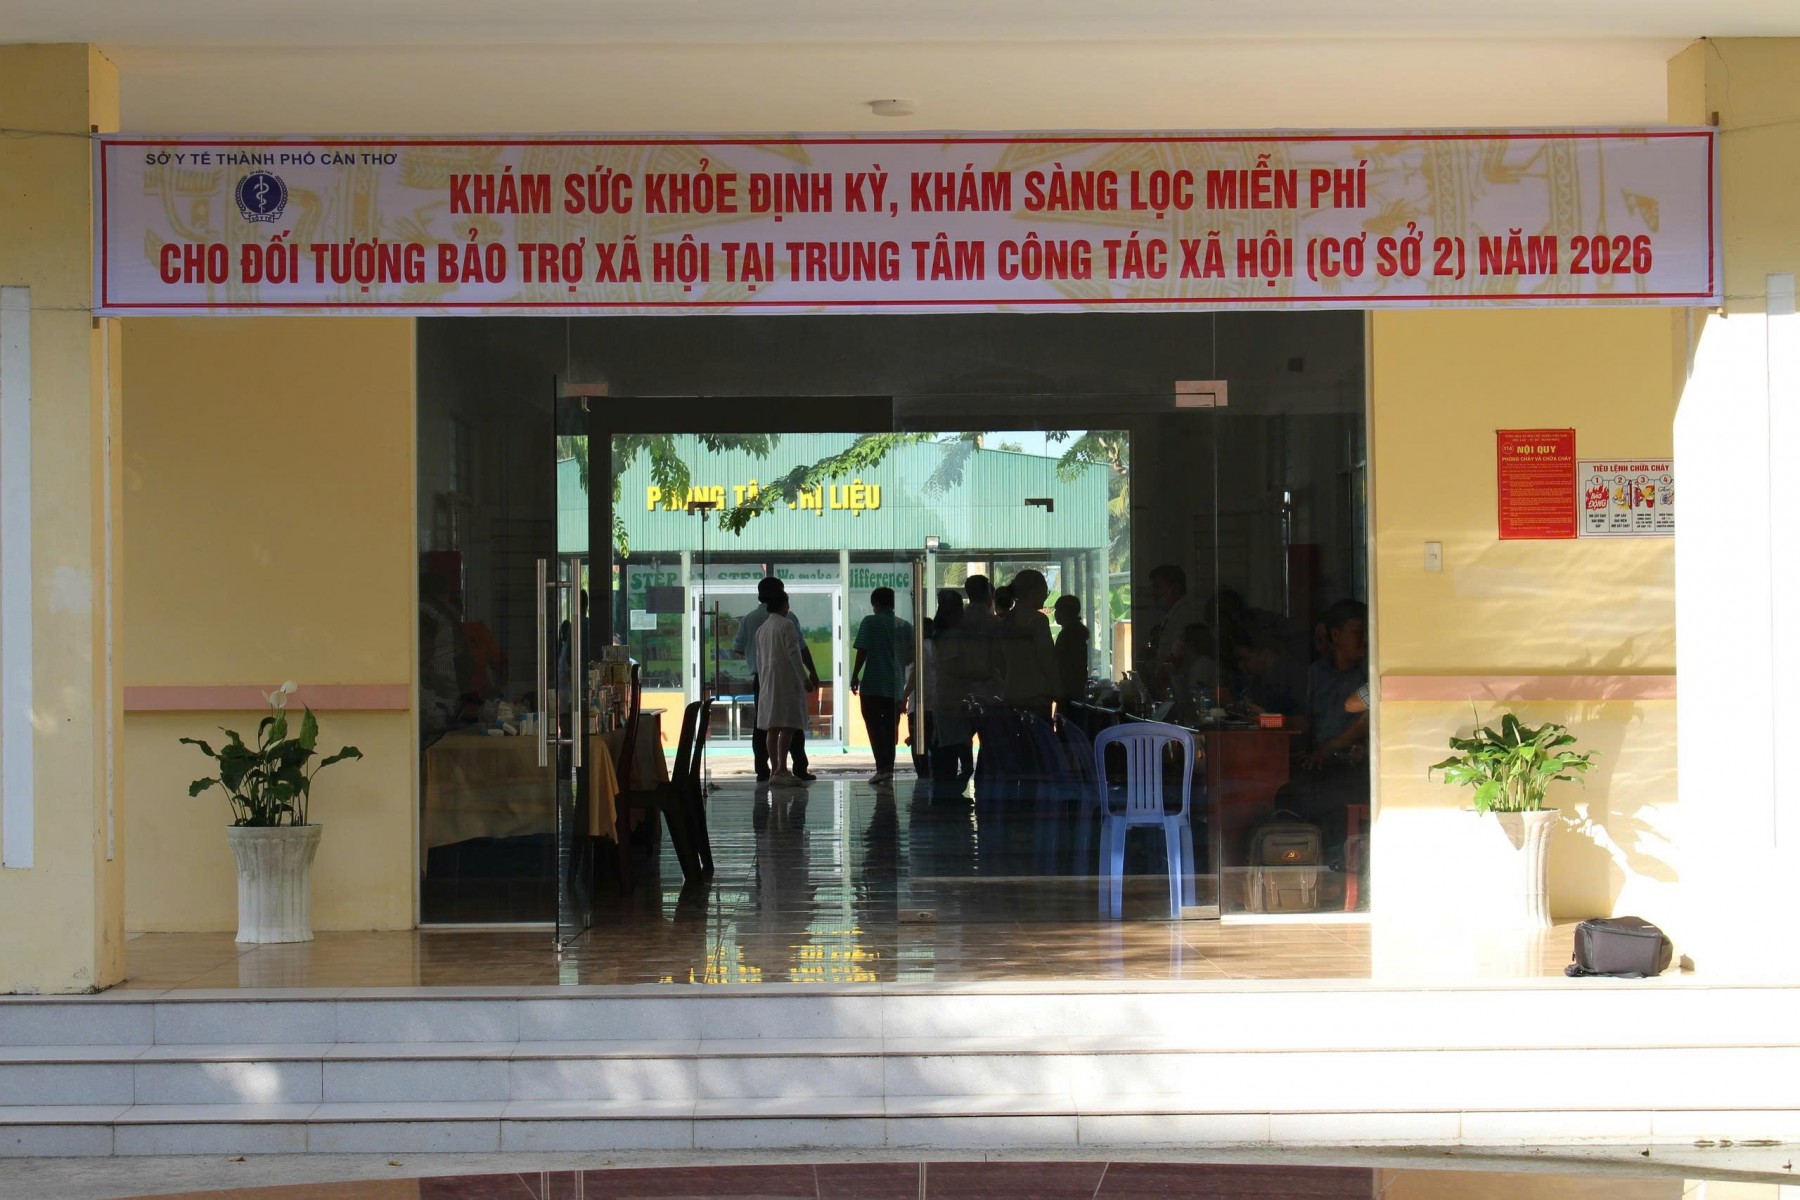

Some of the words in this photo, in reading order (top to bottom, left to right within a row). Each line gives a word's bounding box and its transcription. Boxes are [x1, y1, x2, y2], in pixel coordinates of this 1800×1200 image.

[146, 150, 171, 165] SỞ
[175, 153, 186, 165] Y
[190, 151, 211, 165] TẾ
[216, 151, 274, 165] THÀNH
[280, 151, 315, 165] PHỐ
[321, 151, 355, 165] CẦN
[360, 153, 397, 165] THƠ
[451, 167, 550, 213] KHÁM
[565, 166, 632, 213] SỨC
[646, 159, 736, 213] KHỎE
[749, 173, 831, 221] ĐỊNH
[846, 165, 897, 217] KỲ,
[912, 164, 1011, 211] KHÁM
[1025, 163, 1117, 211] SÀNG
[1131, 170, 1193, 219] LỌC
[1207, 154, 1297, 209] MIỄN
[1310, 161, 1367, 208] PHÍ
[161, 244, 228, 283] CHO
[240, 231, 297, 282] ĐỐI
[312, 240, 424, 291] TƯỢNG
[440, 230, 505, 282] BẢO
[520, 240, 584, 291] TRỢ
[598, 236, 641, 282] XÃ
[654, 235, 709, 291] HỘI
[722, 242, 773, 290] TẠI
[787, 241, 899, 280] TRUNG
[912, 233, 984, 279] TÂM
[999, 233, 1091, 280] CÔNG
[1104, 231, 1167, 279] TÁC
[1181, 231, 1225, 278] XÃ
[1238, 230, 1293, 287] HỘI
[1307, 232, 1366, 281] (CƠ
[1377, 223, 1423, 277] SỞ
[1434, 236, 1465, 280] 2)
[1479, 228, 1557, 275] NĂM
[1570, 235, 1652, 275] 2026
[1517, 445, 1534, 455] NỘI
[1537, 445, 1557, 454] QUY
[1593, 464, 1608, 472] TIÊU
[1610, 463, 1628, 473] LỆNH
[1630, 464, 1649, 472] CHỮA
[1651, 463, 1669, 471] CHÁY
[734, 480, 772, 517] TẬ
[788, 485, 823, 516] RỊ
[830, 477, 881, 516] LIỆU
[631, 571, 678, 590] STEP
